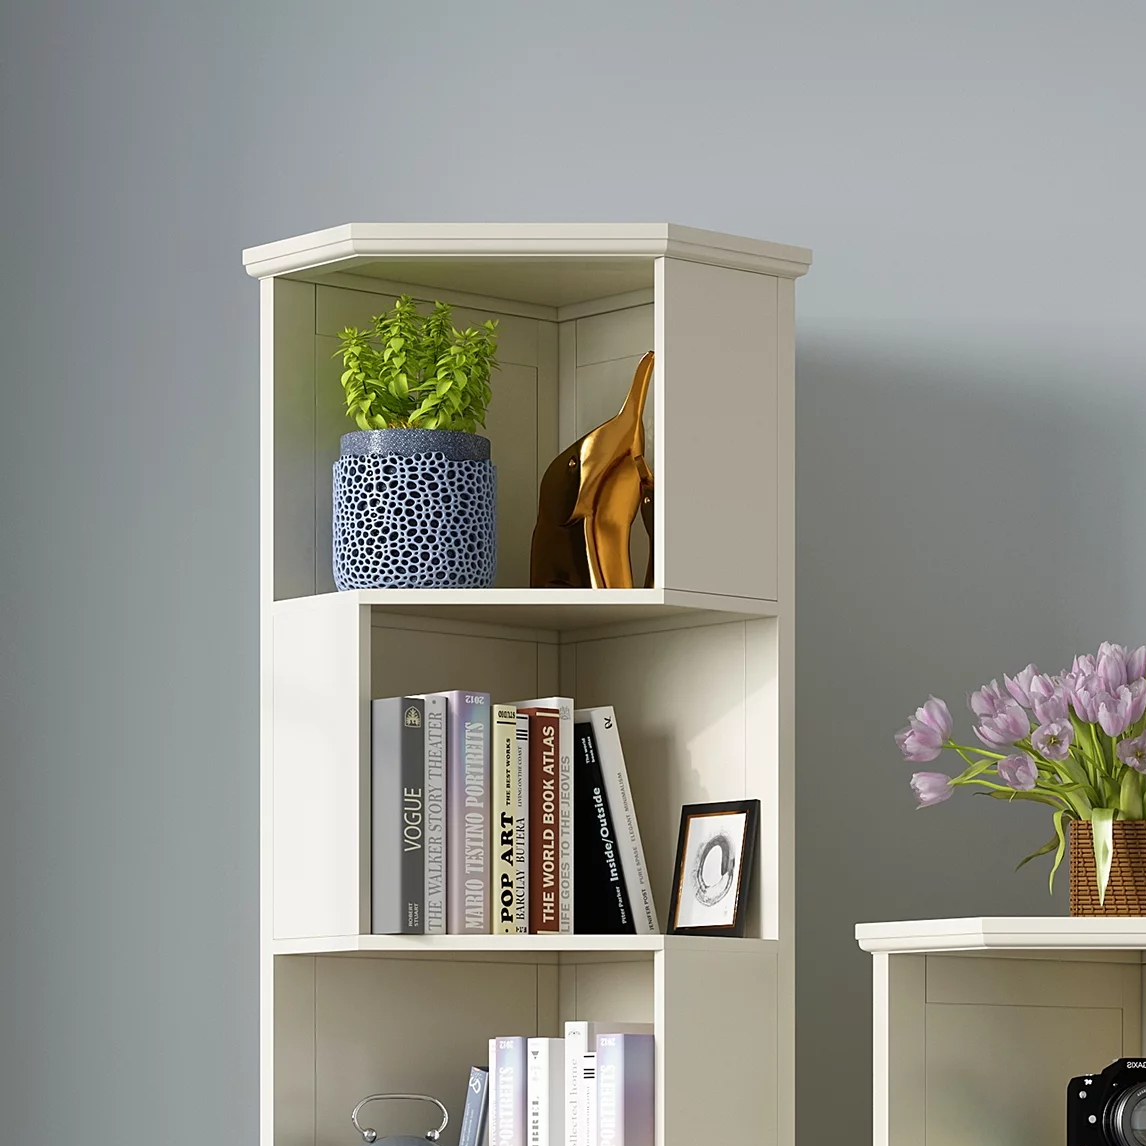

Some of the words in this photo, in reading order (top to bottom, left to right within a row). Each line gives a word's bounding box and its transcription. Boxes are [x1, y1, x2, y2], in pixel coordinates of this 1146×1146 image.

[465, 695, 484, 704] 2012
[429, 712, 442, 779] THEATER
[465, 722, 484, 807] PORTREITS
[542, 726, 554, 775] ATLAS
[542, 778, 554, 824] BOOK
[561, 756, 570, 807] JEOVES
[617, 772, 630, 812] MINIMALISM
[404, 788, 422, 852] VOGUE
[429, 784, 442, 832] STORY
[561, 810, 570, 837] THE
[625, 814, 636, 842] ELEGANT
[465, 812, 484, 873] TESTINO
[501, 812, 514, 866] ART
[516, 818, 525, 863] BUTERA
[561, 840, 570, 858] TO
[592, 787, 620, 881] Inside/Outside
[429, 837, 442, 894] WALKER
[542, 829, 554, 887] WORLD
[561, 862, 570, 899] GOES
[637, 867, 645, 884] PURE
[429, 901, 442, 931] THE
[465, 879, 484, 929] MARIO
[501, 873, 514, 923] POP
[516, 869, 525, 920] BARCLAY
[542, 892, 554, 922] THE
[614, 886, 624, 908] Parker
[618, 909, 627, 924] Piter
[641, 888, 649, 905] POST
[561, 903, 570, 933] LIFE
[644, 906, 655, 931] JENIFER
[569, 1058, 578, 1096] home
